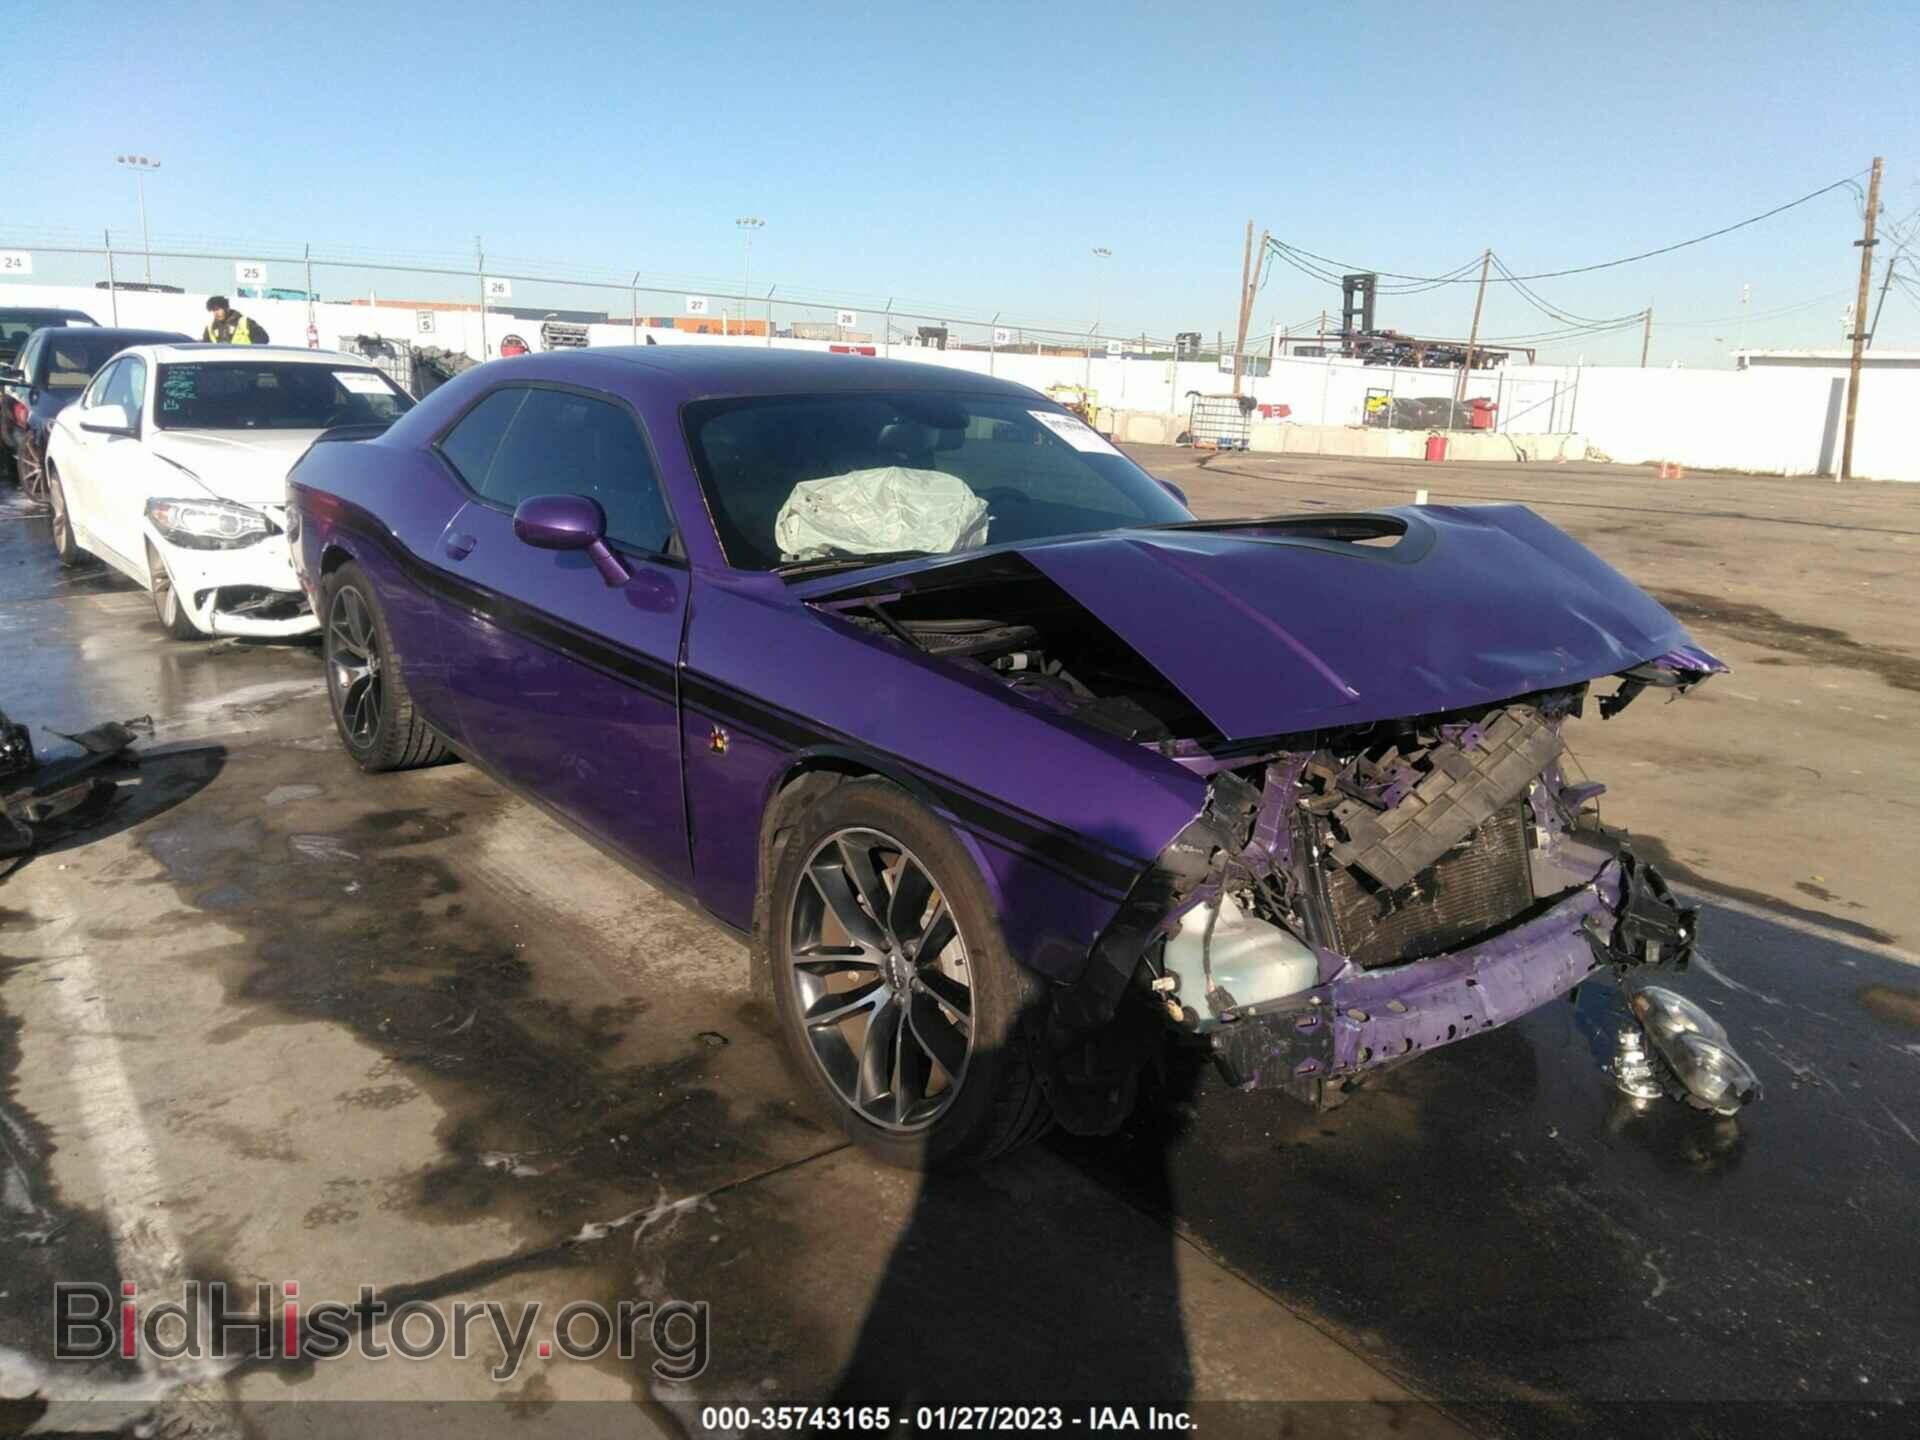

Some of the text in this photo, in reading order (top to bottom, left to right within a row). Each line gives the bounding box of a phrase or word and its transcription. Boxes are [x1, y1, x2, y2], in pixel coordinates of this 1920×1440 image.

[4, 257, 22, 268] 24
[243, 268, 259, 278] 25
[491, 283, 504, 293] 26
[690, 301, 703, 309] 27
